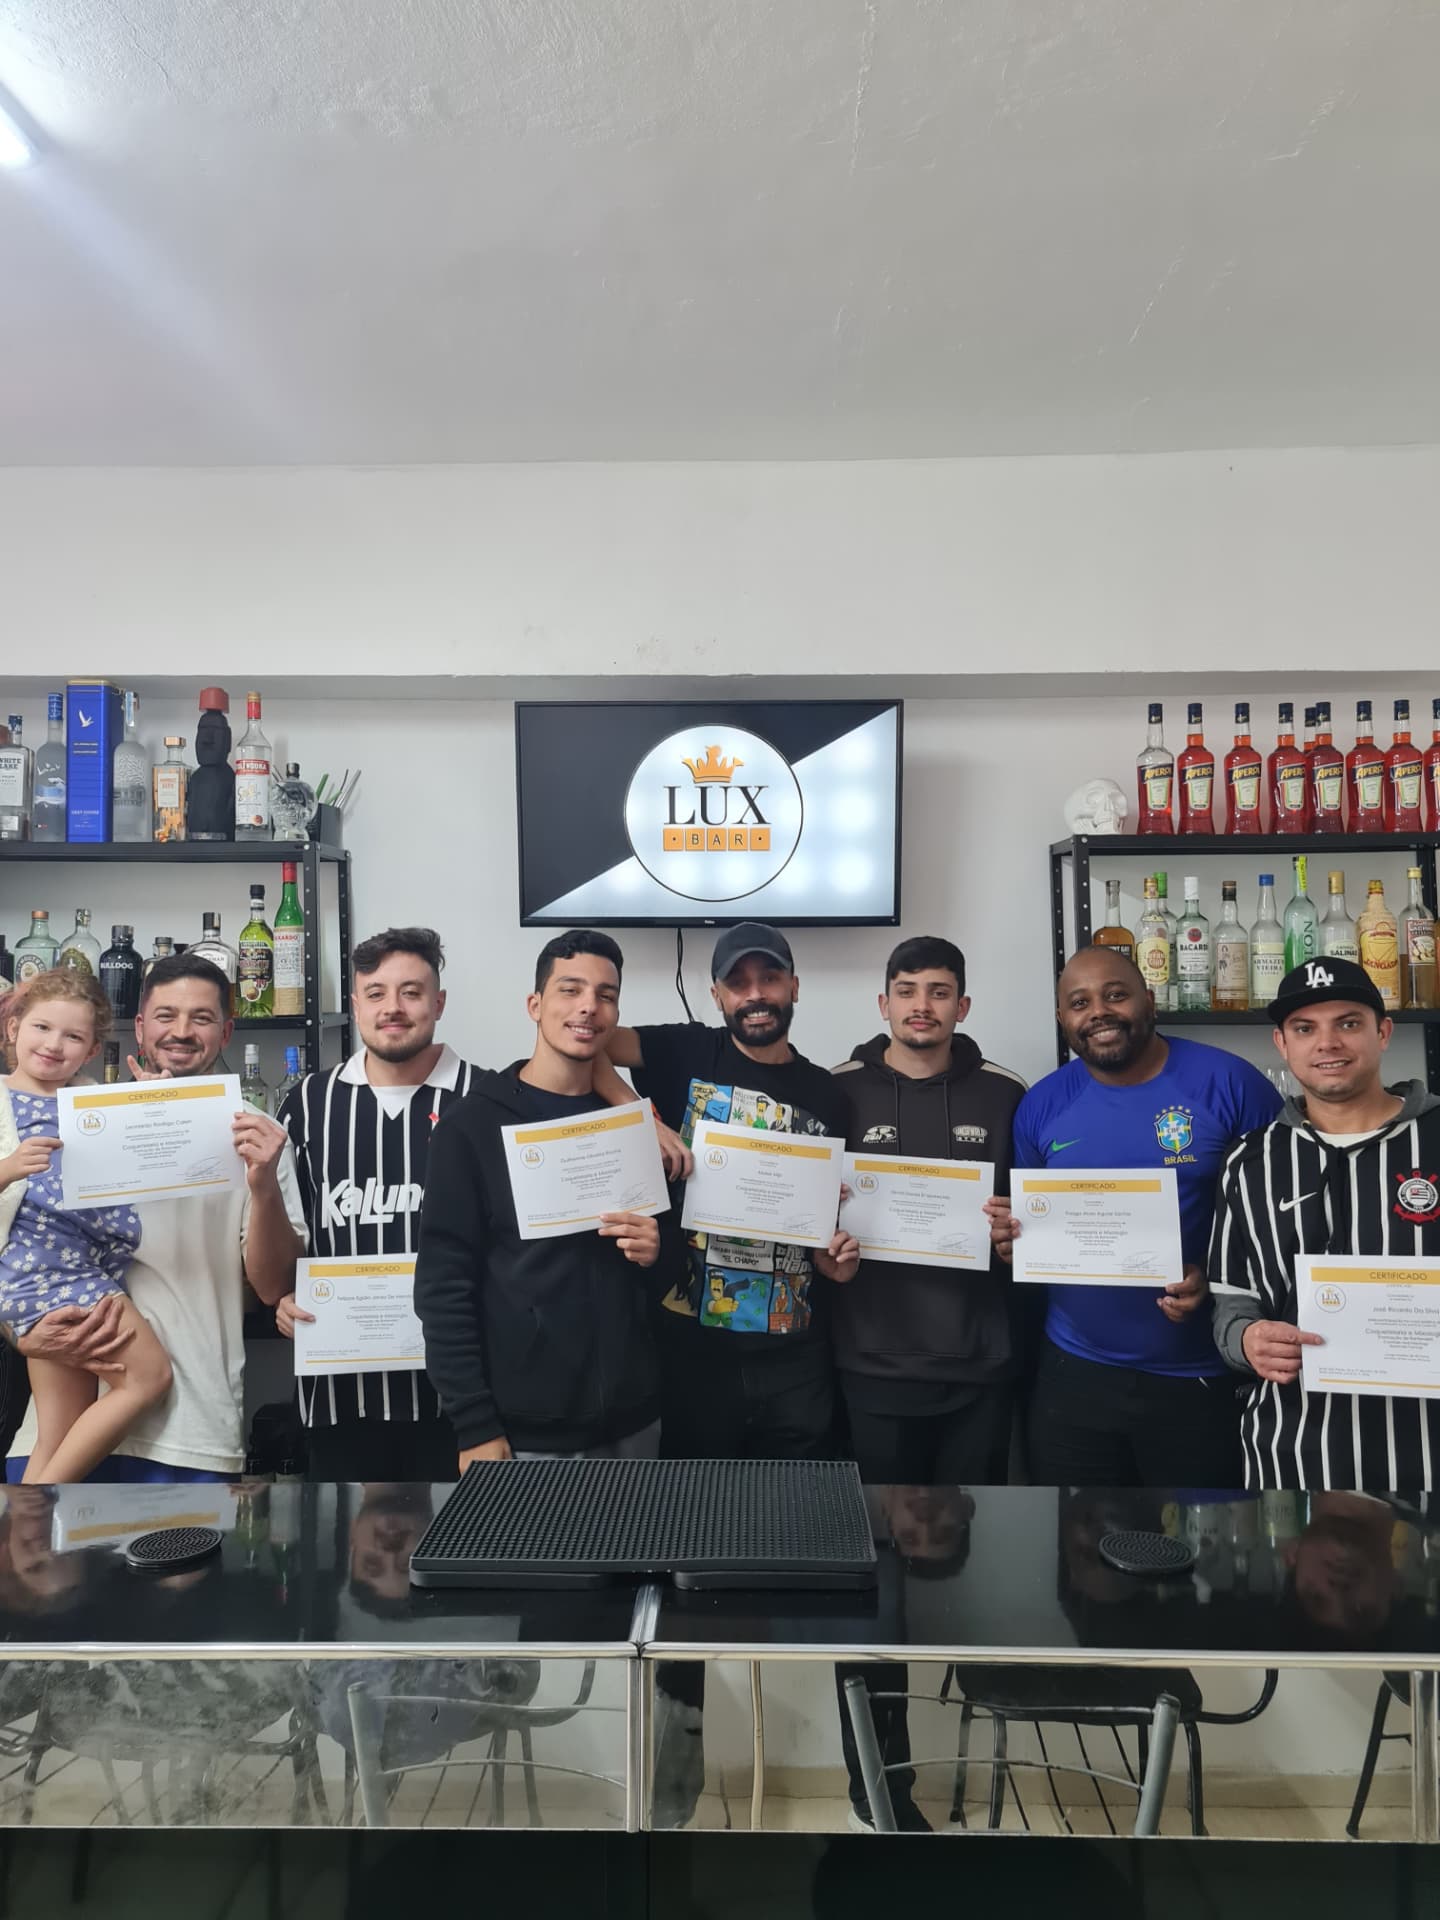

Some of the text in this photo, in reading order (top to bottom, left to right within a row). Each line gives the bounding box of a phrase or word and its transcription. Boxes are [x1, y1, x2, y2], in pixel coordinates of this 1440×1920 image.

[663, 785, 772, 825] LUX
[691, 833, 744, 846] BAR
[1305, 961, 1334, 989] LA
[129, 1090, 178, 1101] CERTIFICADO
[561, 1121, 607, 1135] CERTIFICADO
[750, 1141, 793, 1153] CERTIFICADO
[1164, 1155, 1198, 1166] BRASIL
[897, 1165, 940, 1174] CERTIFICADO
[355, 1265, 400, 1273] CERTIFICADO
[1369, 1271, 1428, 1281] CERTIFICADO
